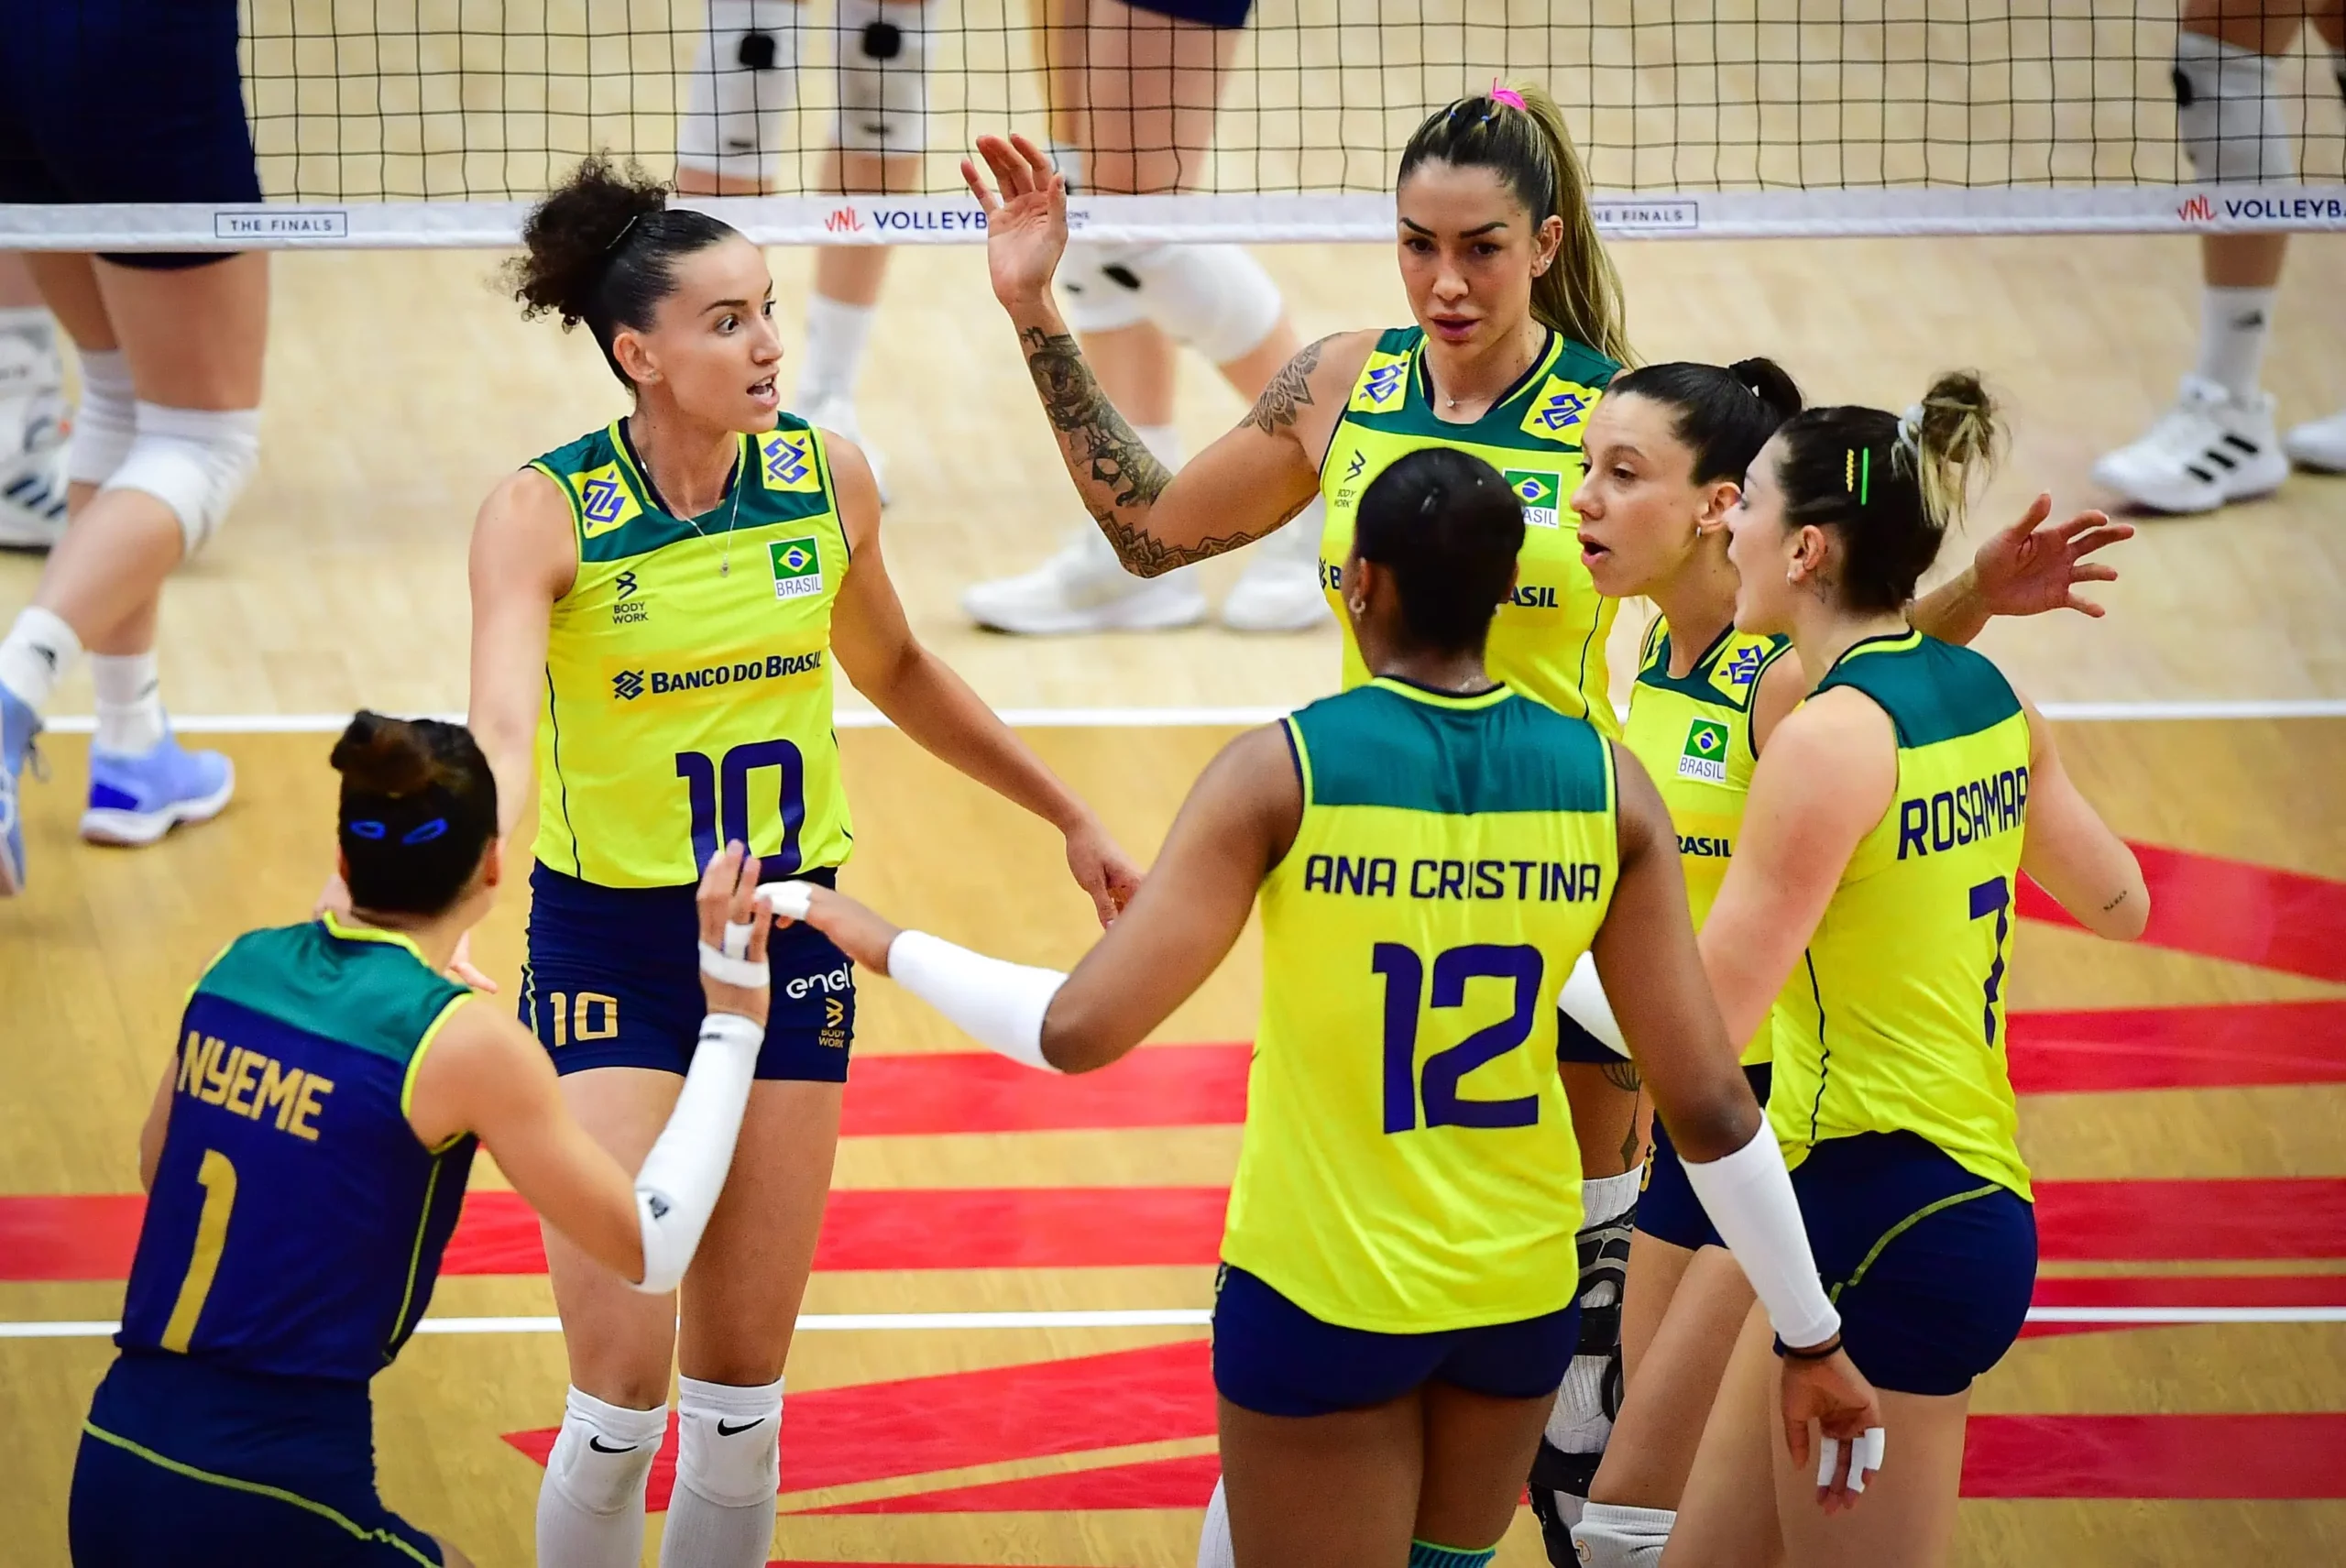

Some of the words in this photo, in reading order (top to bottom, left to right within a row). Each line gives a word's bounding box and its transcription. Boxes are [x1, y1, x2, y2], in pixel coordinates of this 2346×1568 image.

[1622, 210, 1683, 221] FINALS
[2225, 199, 2346, 218] VOLLEYB
[231, 220, 261, 231] THE
[271, 219, 332, 231] FINALS
[873, 211, 988, 229] VOLLEYB
[1523, 509, 1557, 525] ASIL
[776, 576, 821, 597] BRASIL
[1510, 586, 1559, 608] ASIL
[612, 611, 649, 624] WORK
[613, 602, 645, 614] BODY
[651, 666, 729, 694] BANCO
[733, 662, 762, 682] DO
[765, 651, 821, 678] BRASIL
[1679, 757, 1724, 779] BRASIL
[675, 739, 806, 881] 10
[1304, 854, 1397, 897] ANA
[1409, 860, 1601, 902] CRISTINA
[1969, 875, 2011, 1048] 7
[785, 962, 851, 999] enel
[550, 992, 619, 1047] 10
[818, 1036, 844, 1048] WORK
[821, 1029, 845, 1037] BODY
[1372, 942, 1544, 1135] 12
[177, 1030, 335, 1142] NYEME
[159, 1148, 237, 1354] 1
